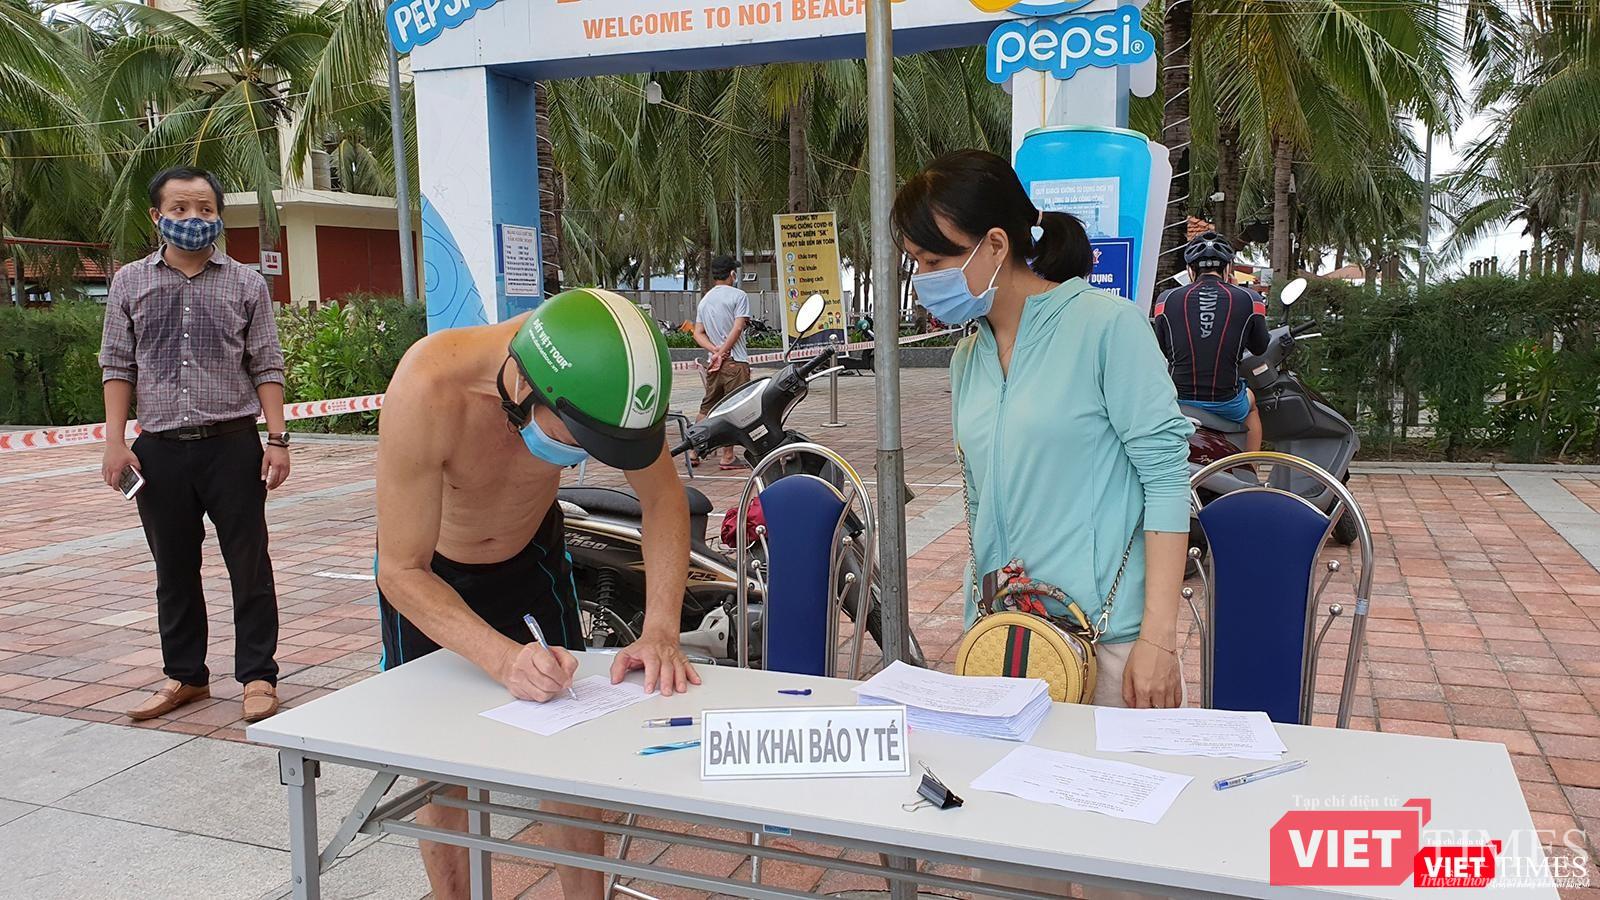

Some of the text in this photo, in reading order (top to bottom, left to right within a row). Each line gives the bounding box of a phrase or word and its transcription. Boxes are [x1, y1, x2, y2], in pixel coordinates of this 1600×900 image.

[583, 10, 693, 39] WELCOME
[704, 7, 730, 29] TO
[1091, 273, 1113, 285] DỤNG
[709, 719, 900, 765] BÀN KHAI BÁO Y TẾ
